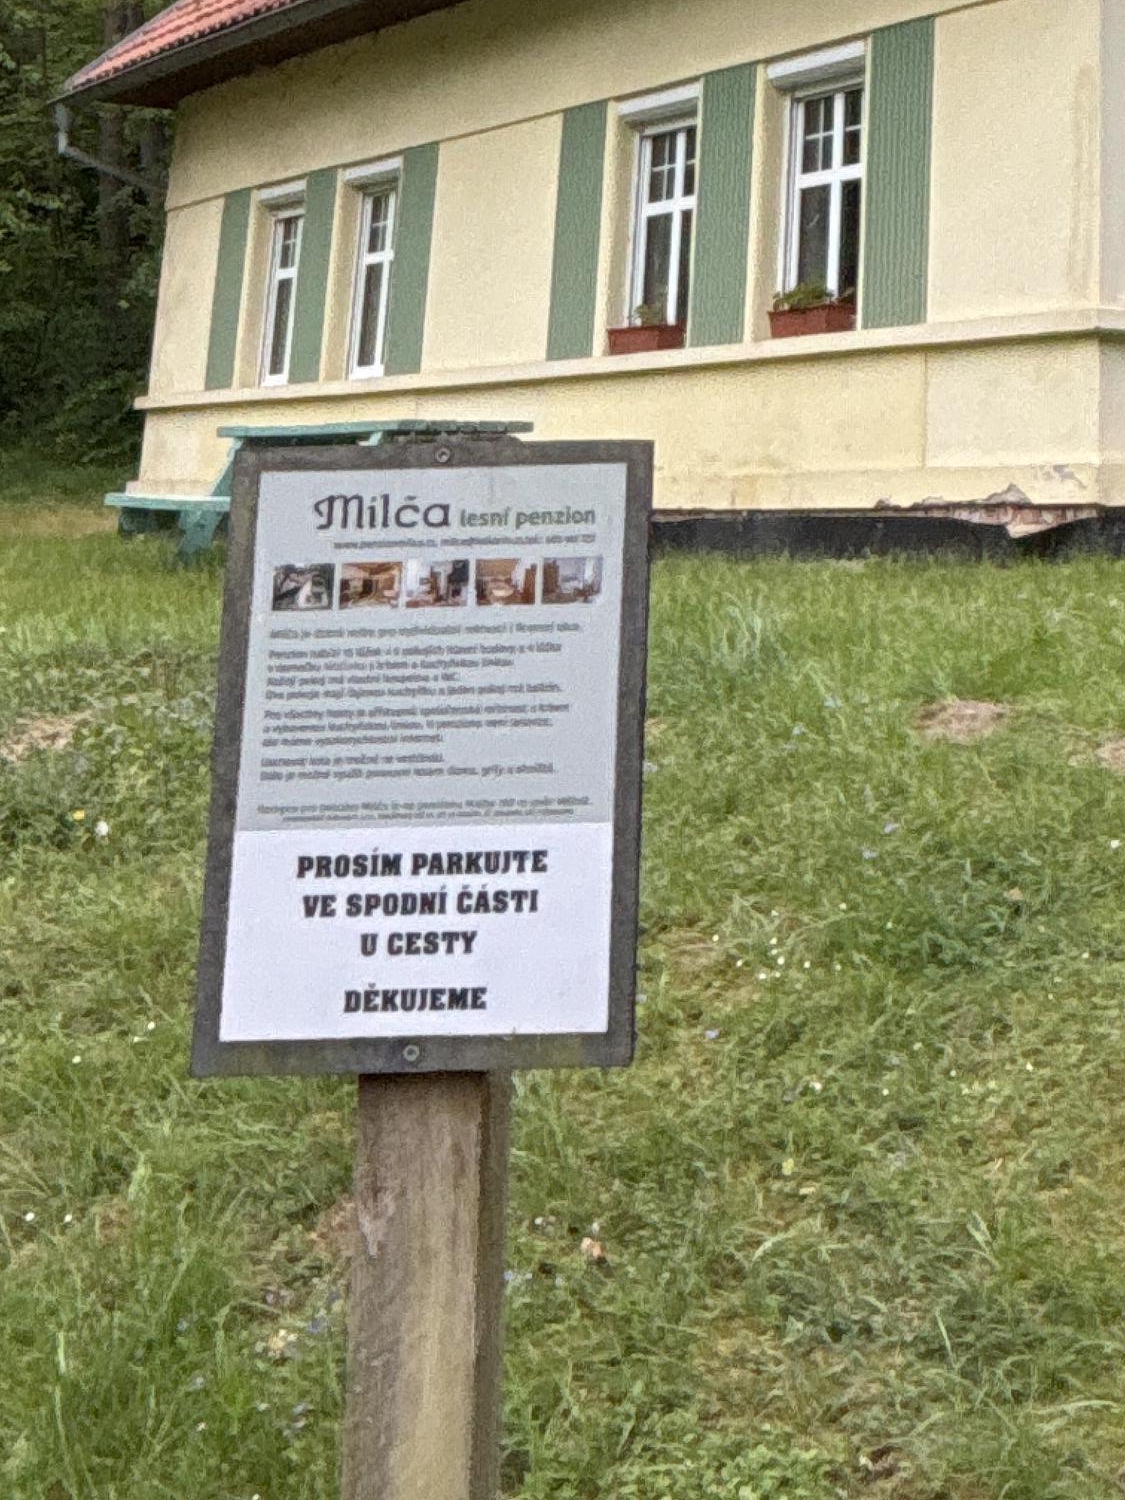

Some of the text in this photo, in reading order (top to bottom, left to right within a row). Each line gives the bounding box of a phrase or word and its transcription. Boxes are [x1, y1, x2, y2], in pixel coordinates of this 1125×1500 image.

[314, 493, 596, 529] Milča lesní penzion
[297, 847, 549, 878] PROSÍM PARKUJTE
[302, 884, 538, 917] VE SPODNÍ ČÁSTI
[360, 931, 478, 956] U CESTY
[343, 982, 488, 1013] DĚKUJEME
